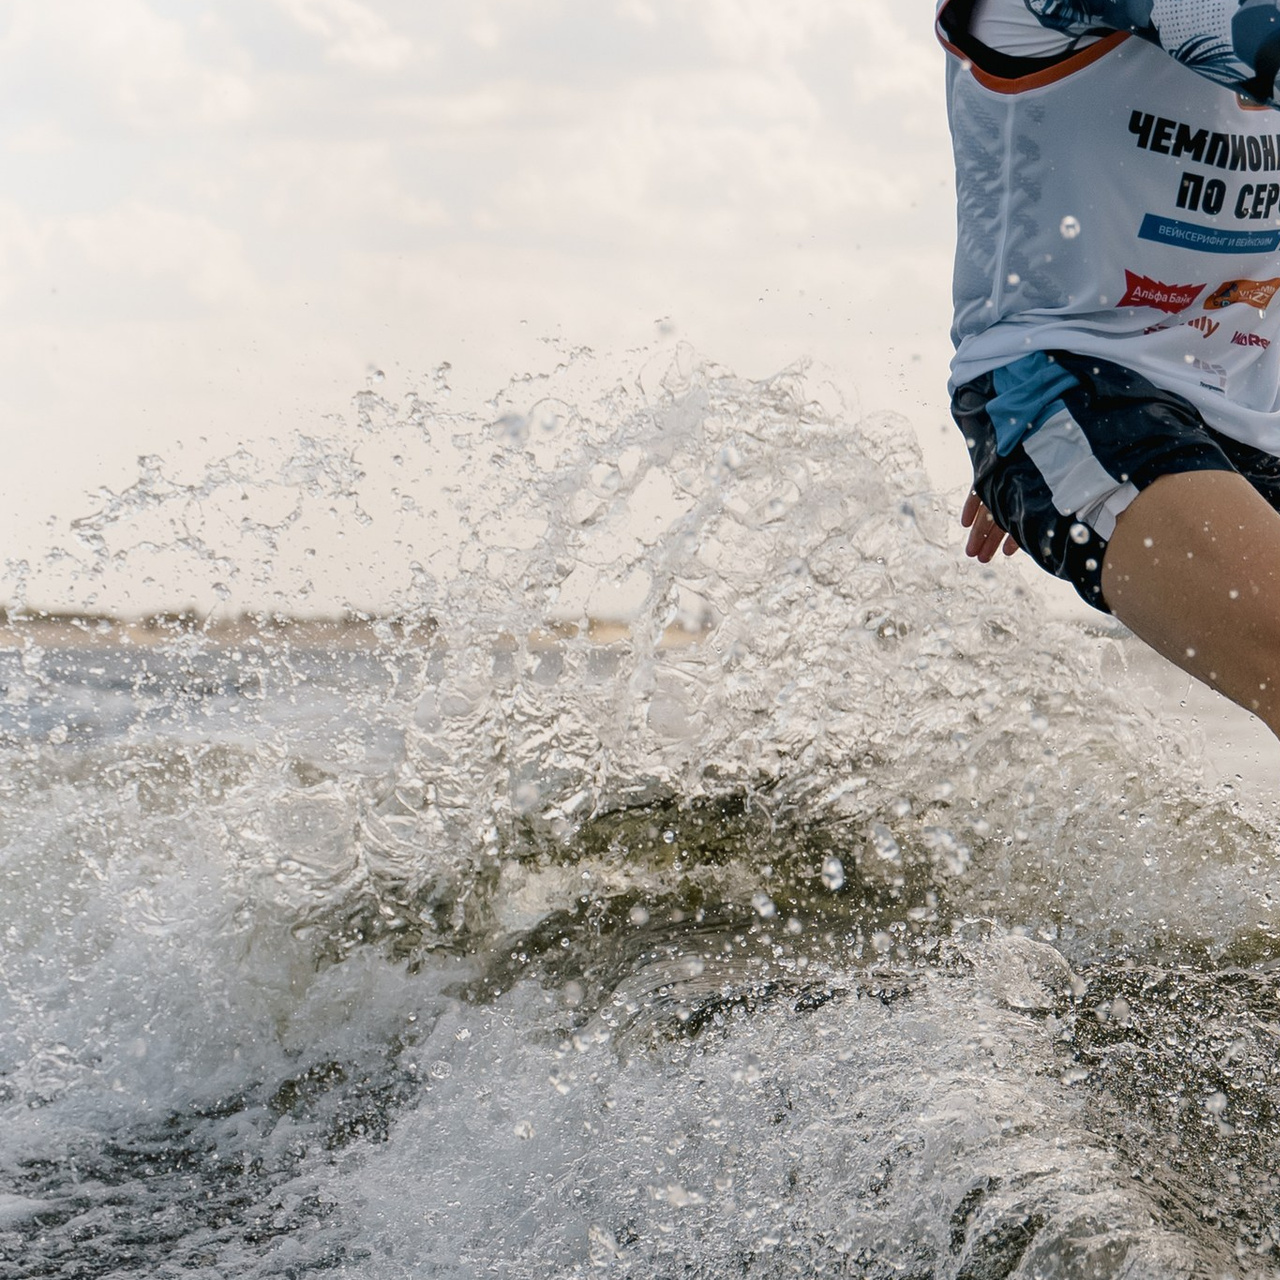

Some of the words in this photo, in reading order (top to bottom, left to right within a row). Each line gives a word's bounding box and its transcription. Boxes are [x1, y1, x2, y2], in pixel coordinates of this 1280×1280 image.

[1176, 171, 1226, 216] ПО
[1227, 237, 1235, 246] И
[1131, 285, 1168, 303] Альфа
[1168, 292, 1193, 304] Банк
